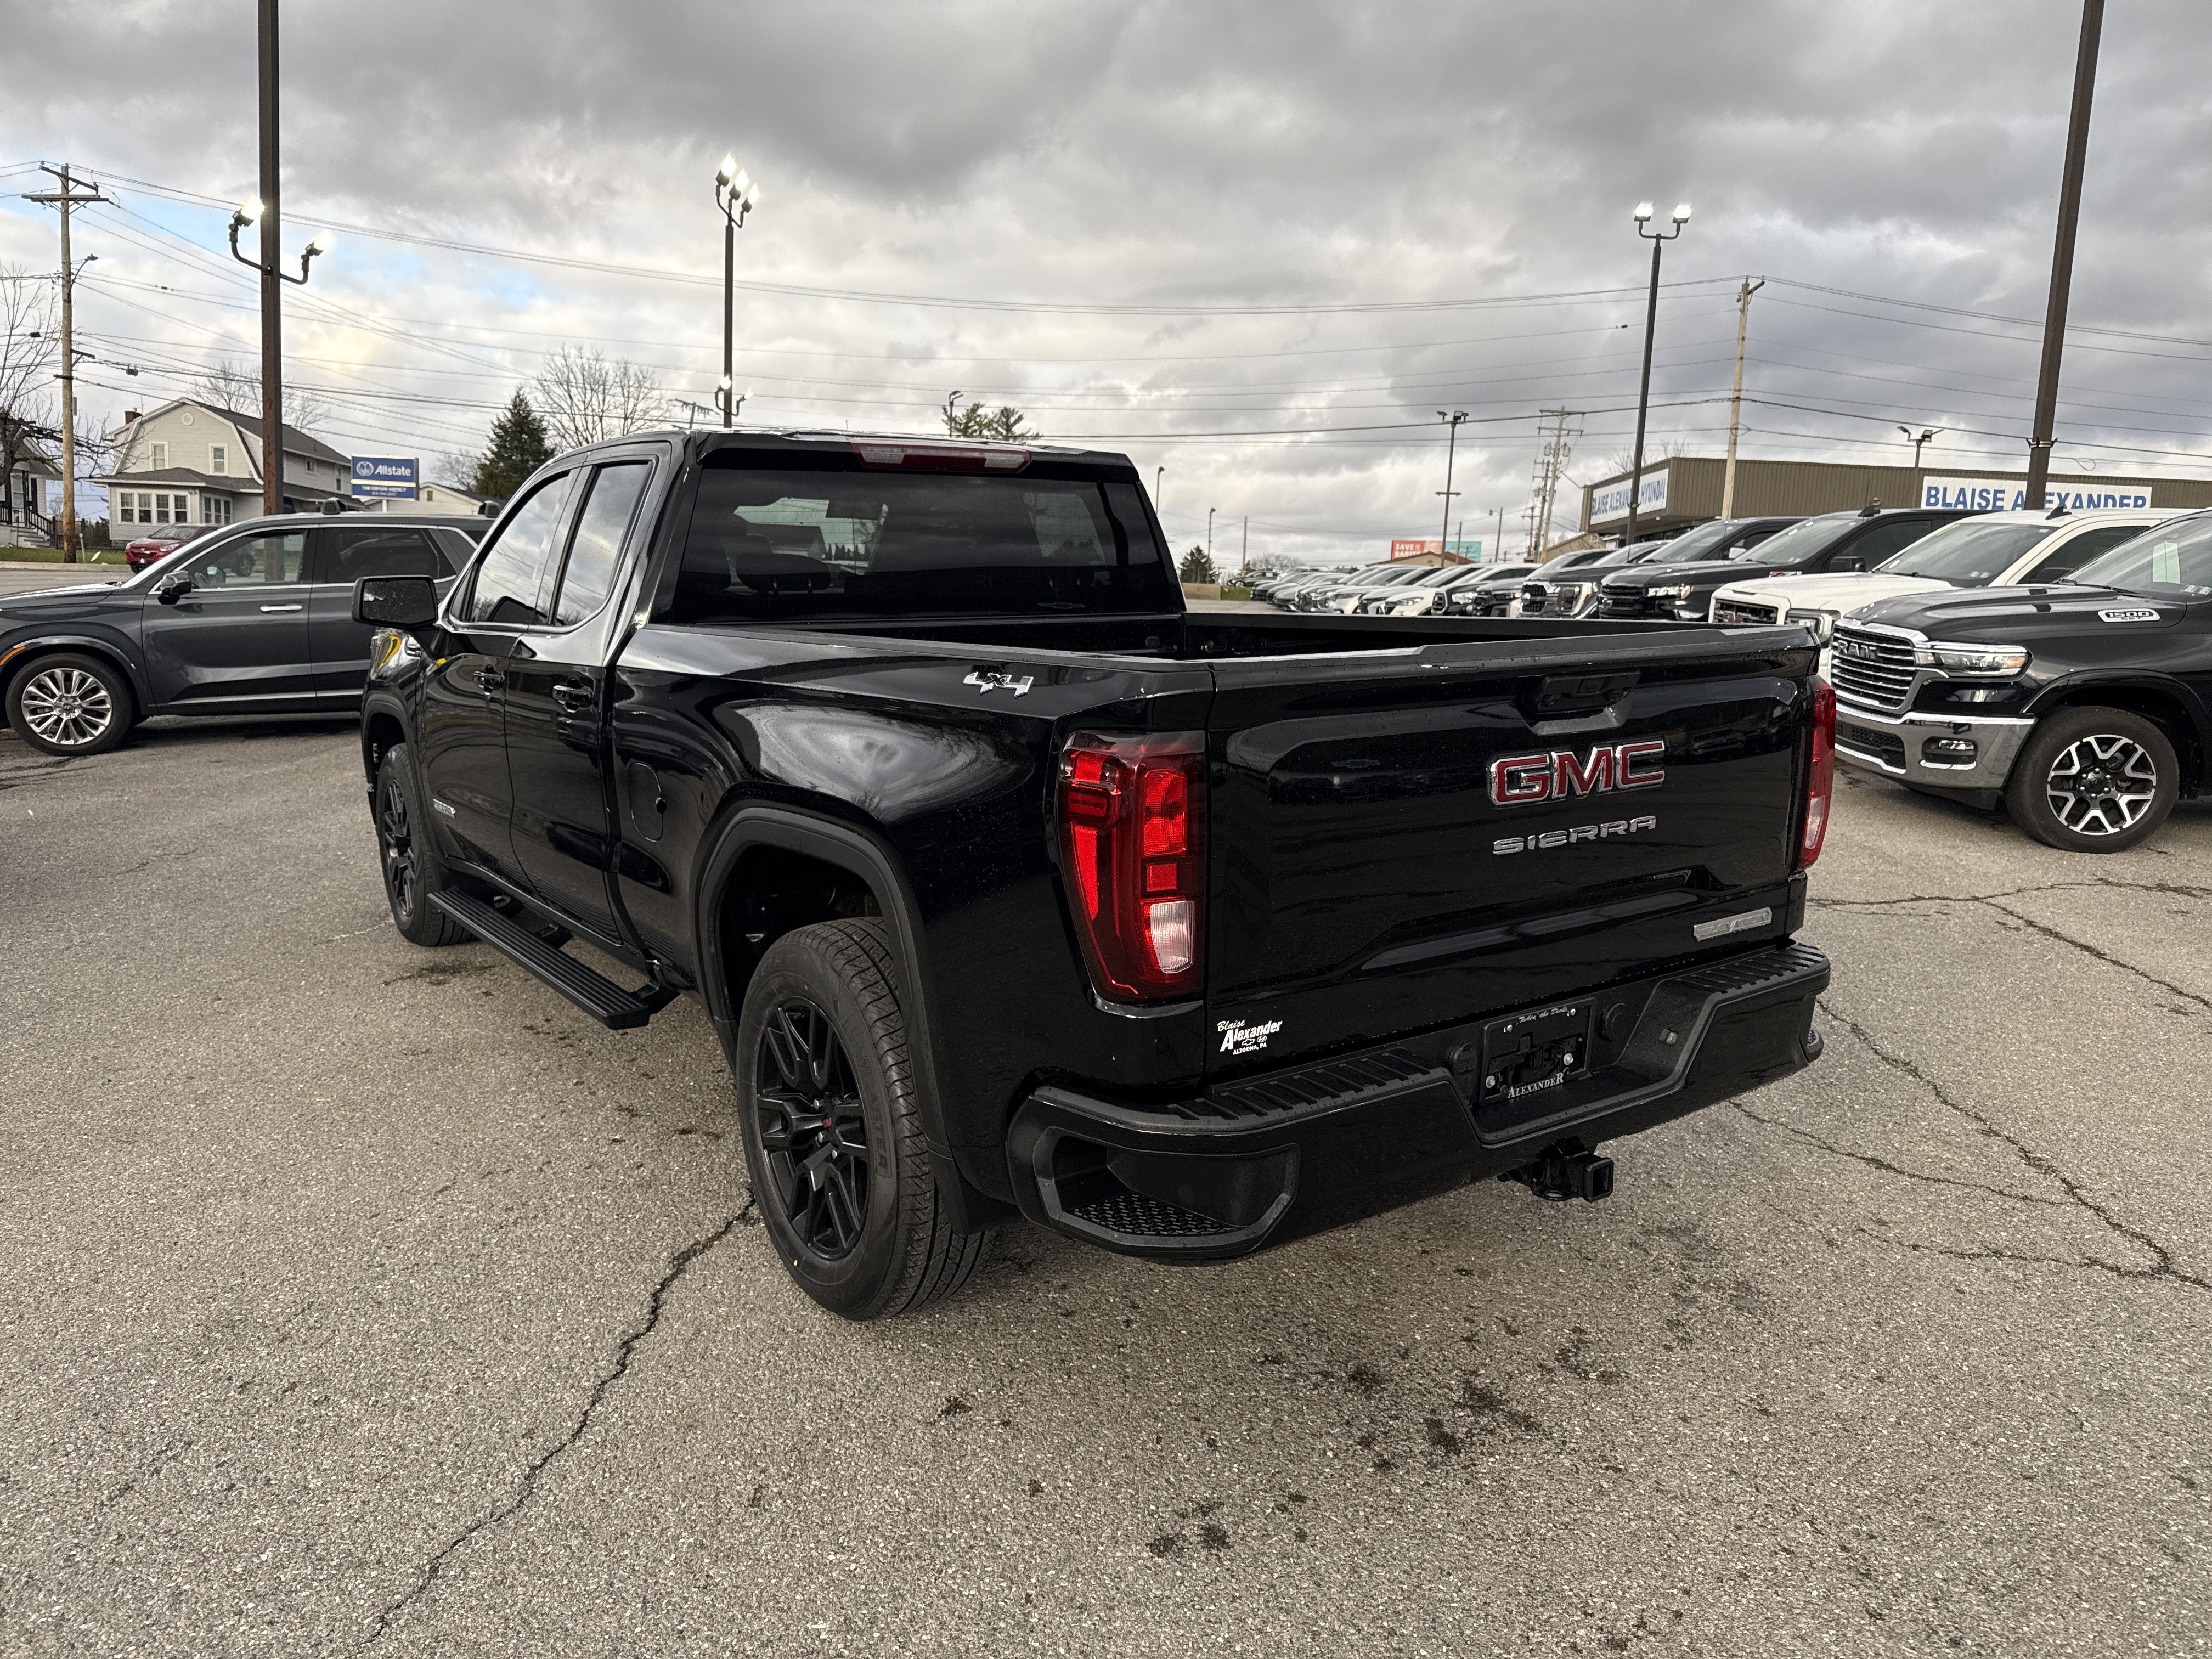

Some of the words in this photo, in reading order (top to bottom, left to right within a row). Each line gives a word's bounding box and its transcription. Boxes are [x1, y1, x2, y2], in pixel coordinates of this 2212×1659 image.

[374, 465, 411, 476] Allstate
[1592, 494, 1609, 516] BLAISE
[1641, 478, 1666, 504] HYUNDAI
[1926, 486, 2005, 511] BLAISE
[2011, 490, 2147, 510] AEXANDER
[1837, 640, 1877, 660] RAM
[1489, 740, 1665, 805] GMC
[1493, 816, 1656, 855] SIERRA
[1217, 1020, 1245, 1031] Blaise
[1220, 1020, 1283, 1052] Alexander
[1233, 1045, 1259, 1055] ALTOONA,
[1508, 1072, 1564, 1099] ALEXANDER
